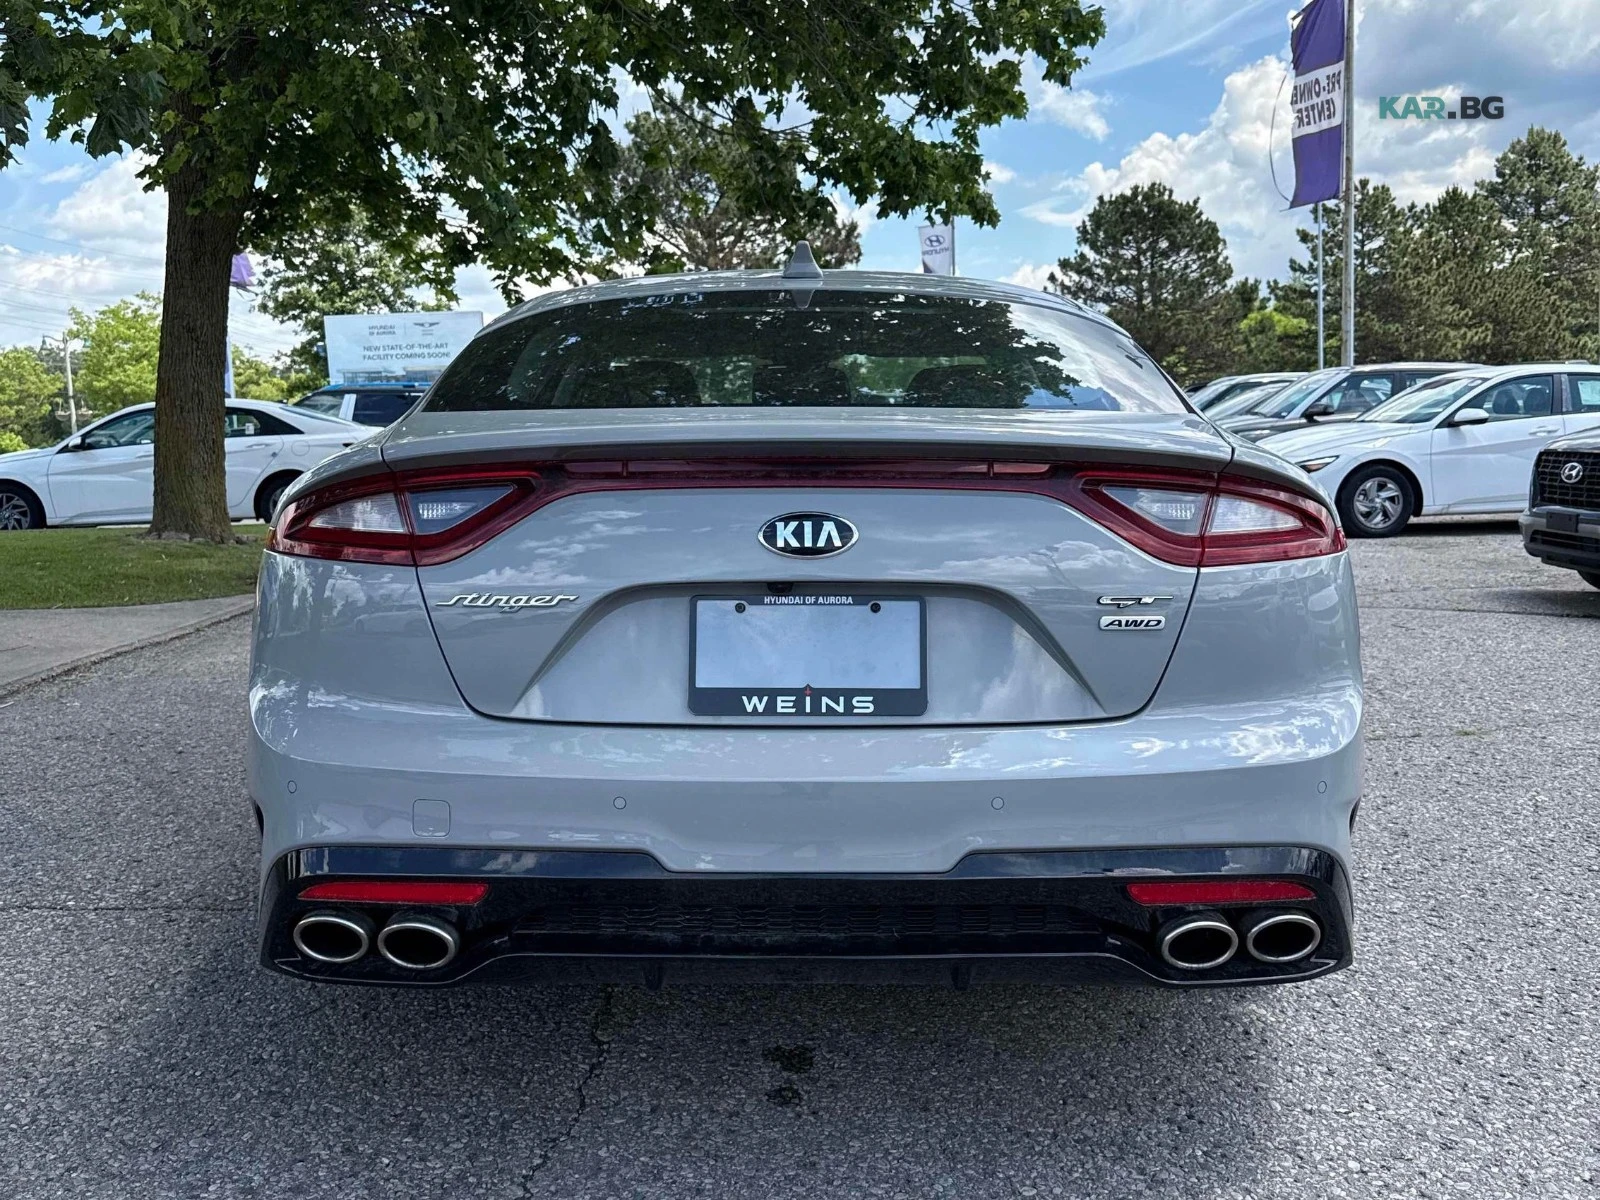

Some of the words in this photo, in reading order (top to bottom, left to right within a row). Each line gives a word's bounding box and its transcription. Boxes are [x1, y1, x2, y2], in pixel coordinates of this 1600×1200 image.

[382, 342, 448, 351] STATE-OF-THE-ART
[363, 353, 394, 361] FACILITY
[395, 352, 426, 360] COMING
[775, 521, 842, 547] KIA
[764, 596, 803, 604] HYUNDAI
[805, 596, 816, 604] OF
[818, 596, 853, 604] AURORA
[1098, 596, 1173, 608] GT
[1104, 619, 1162, 628] AWD
[742, 695, 875, 713] WEINS
